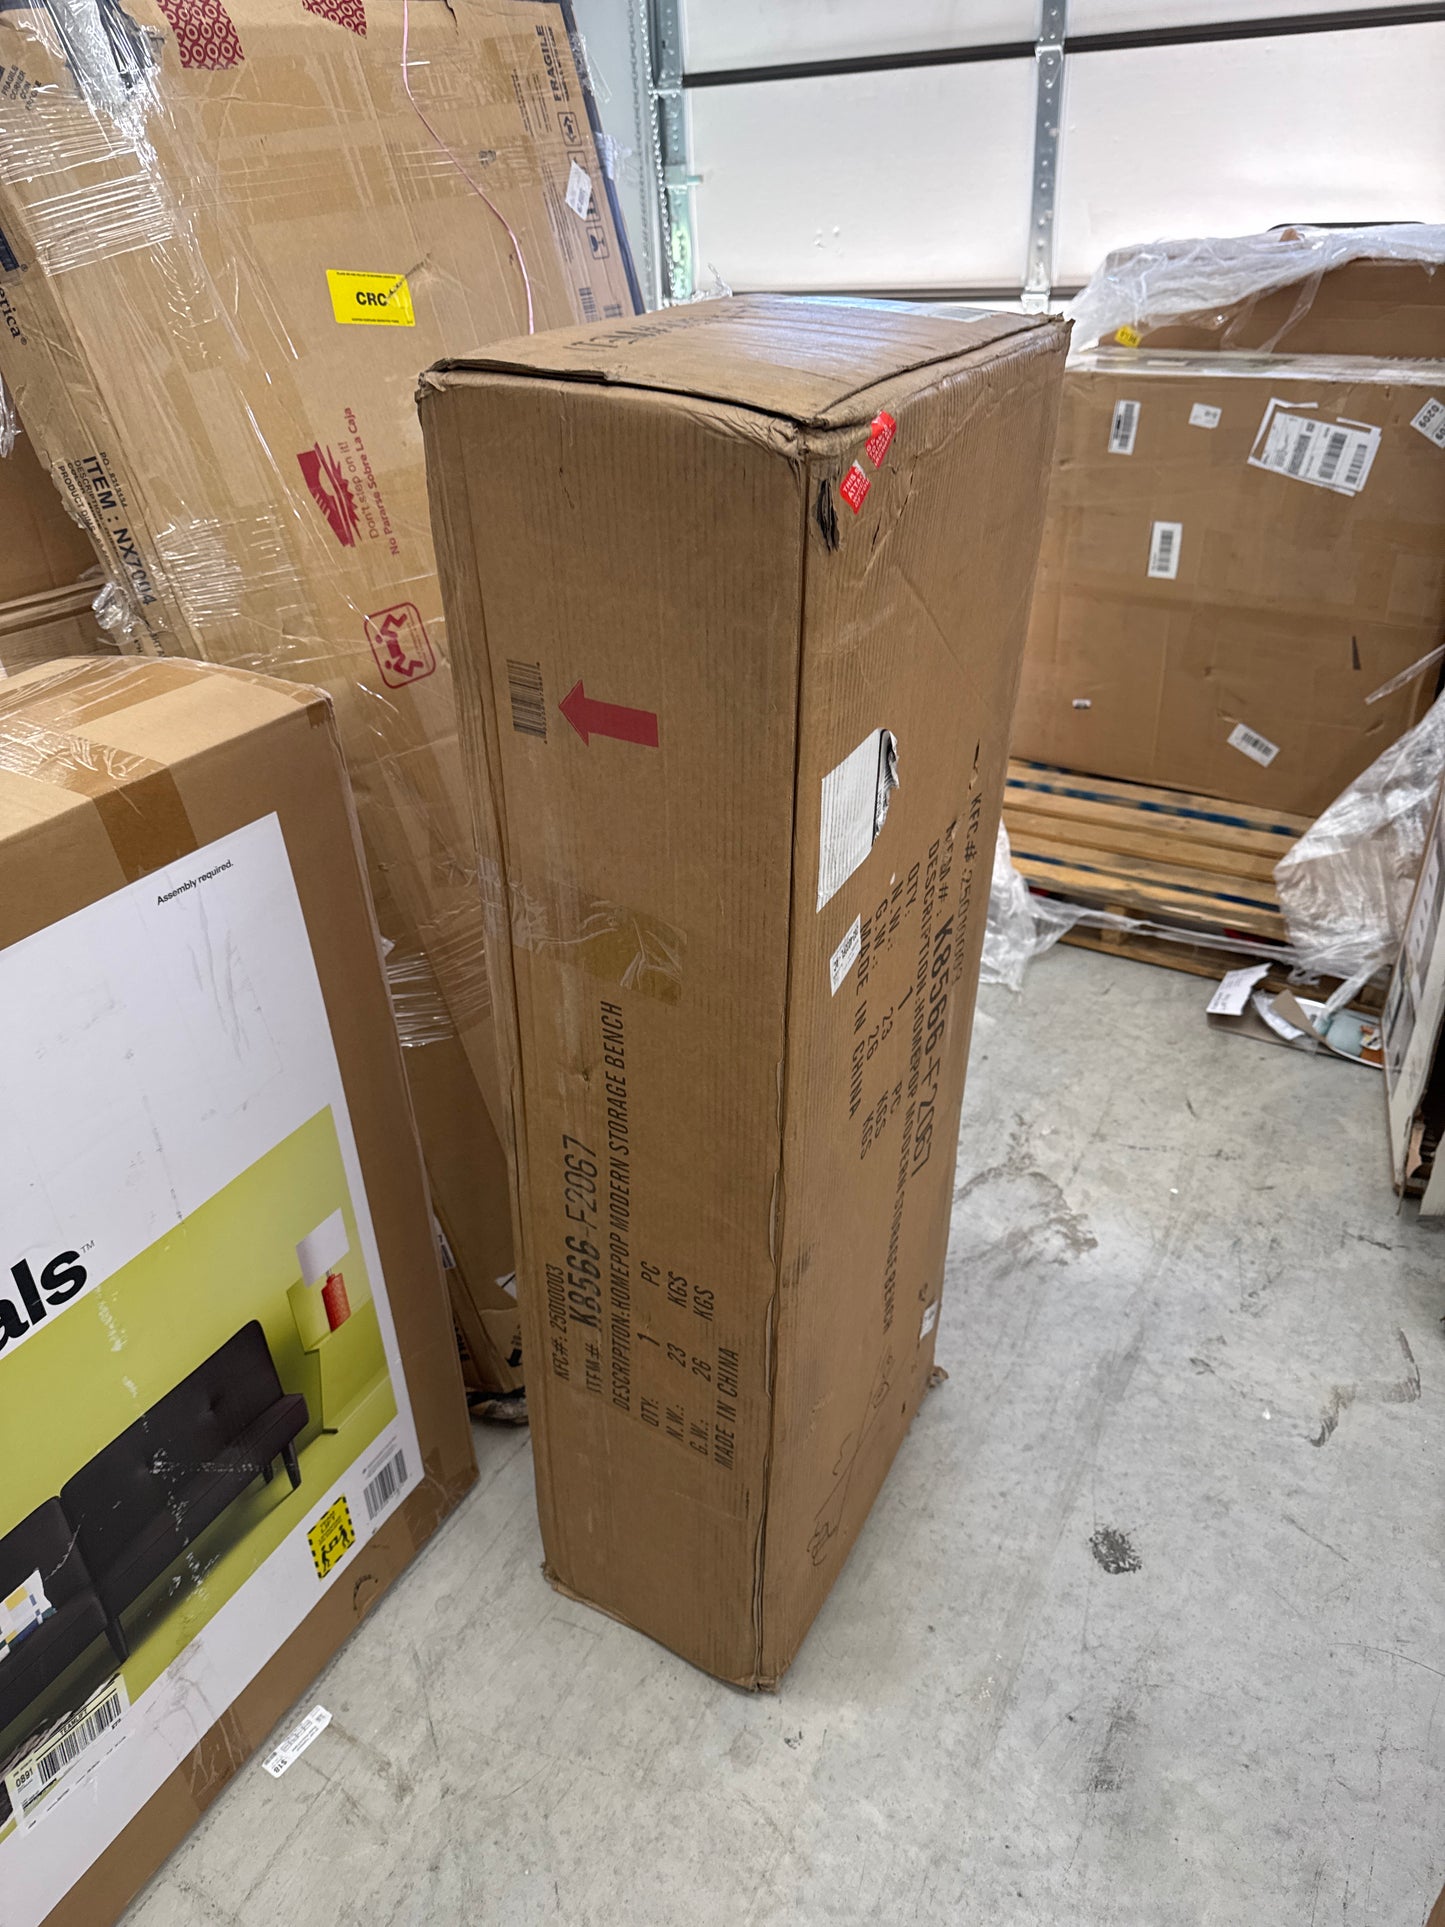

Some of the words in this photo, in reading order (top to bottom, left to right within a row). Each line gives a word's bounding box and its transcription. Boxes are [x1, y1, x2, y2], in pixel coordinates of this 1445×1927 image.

[535, 25, 562, 102] FRAGILE
[355, 291, 388, 306] CRC
[344, 407, 358, 434] Caja
[354, 436, 365, 452] La
[345, 456, 357, 473] on
[360, 454, 378, 490] Sobre
[58, 465, 86, 509] PRODUCT
[352, 474, 367, 504] step
[82, 455, 117, 510] ITEM
[112, 527, 158, 606] NX7004
[361, 505, 380, 540] Don't
[374, 491, 393, 536] Pararse
[389, 537, 400, 556] No
[157, 879, 197, 905] Assembly
[197, 858, 234, 883] required.
[904, 862, 920, 918] QTY:
[872, 898, 888, 970] G.W.:
[888, 880, 904, 950] N.W.:
[856, 917, 873, 996] MADE
[897, 985, 914, 1010] 1
[600, 1000, 625, 1071] BENCH
[854, 1000, 867, 1035] IN
[881, 1006, 894, 1040] 23
[866, 1025, 879, 1061] 26
[911, 914, 954, 1178] K8566-F2067
[849, 1040, 865, 1120] CHINA
[890, 1080, 902, 1115] PC
[605, 1071, 630, 1156] STORAGE
[874, 1090, 889, 1139] KGS
[860, 1110, 874, 1160] KGS
[896, 1101, 916, 1194] MODERN
[610, 1157, 630, 1233] MODERN
[562, 1133, 602, 1331] K8566-F2067
[640, 1260, 660, 1288] PC
[667, 1270, 688, 1309] KGS
[545, 1264, 567, 1334] 25010003
[693, 1285, 715, 1322] KGS
[637, 1332, 660, 1347] 1
[667, 1342, 687, 1369] 23
[692, 1356, 712, 1383] 26
[717, 1346, 739, 1399] CHINA
[640, 1396, 660, 1428] QTY:
[666, 1404, 685, 1443] N.W.:
[716, 1401, 737, 1423] IN
[690, 1419, 709, 1456] G.W.:
[714, 1424, 736, 1471] MADE
[15, 1767, 34, 1788] 0891
